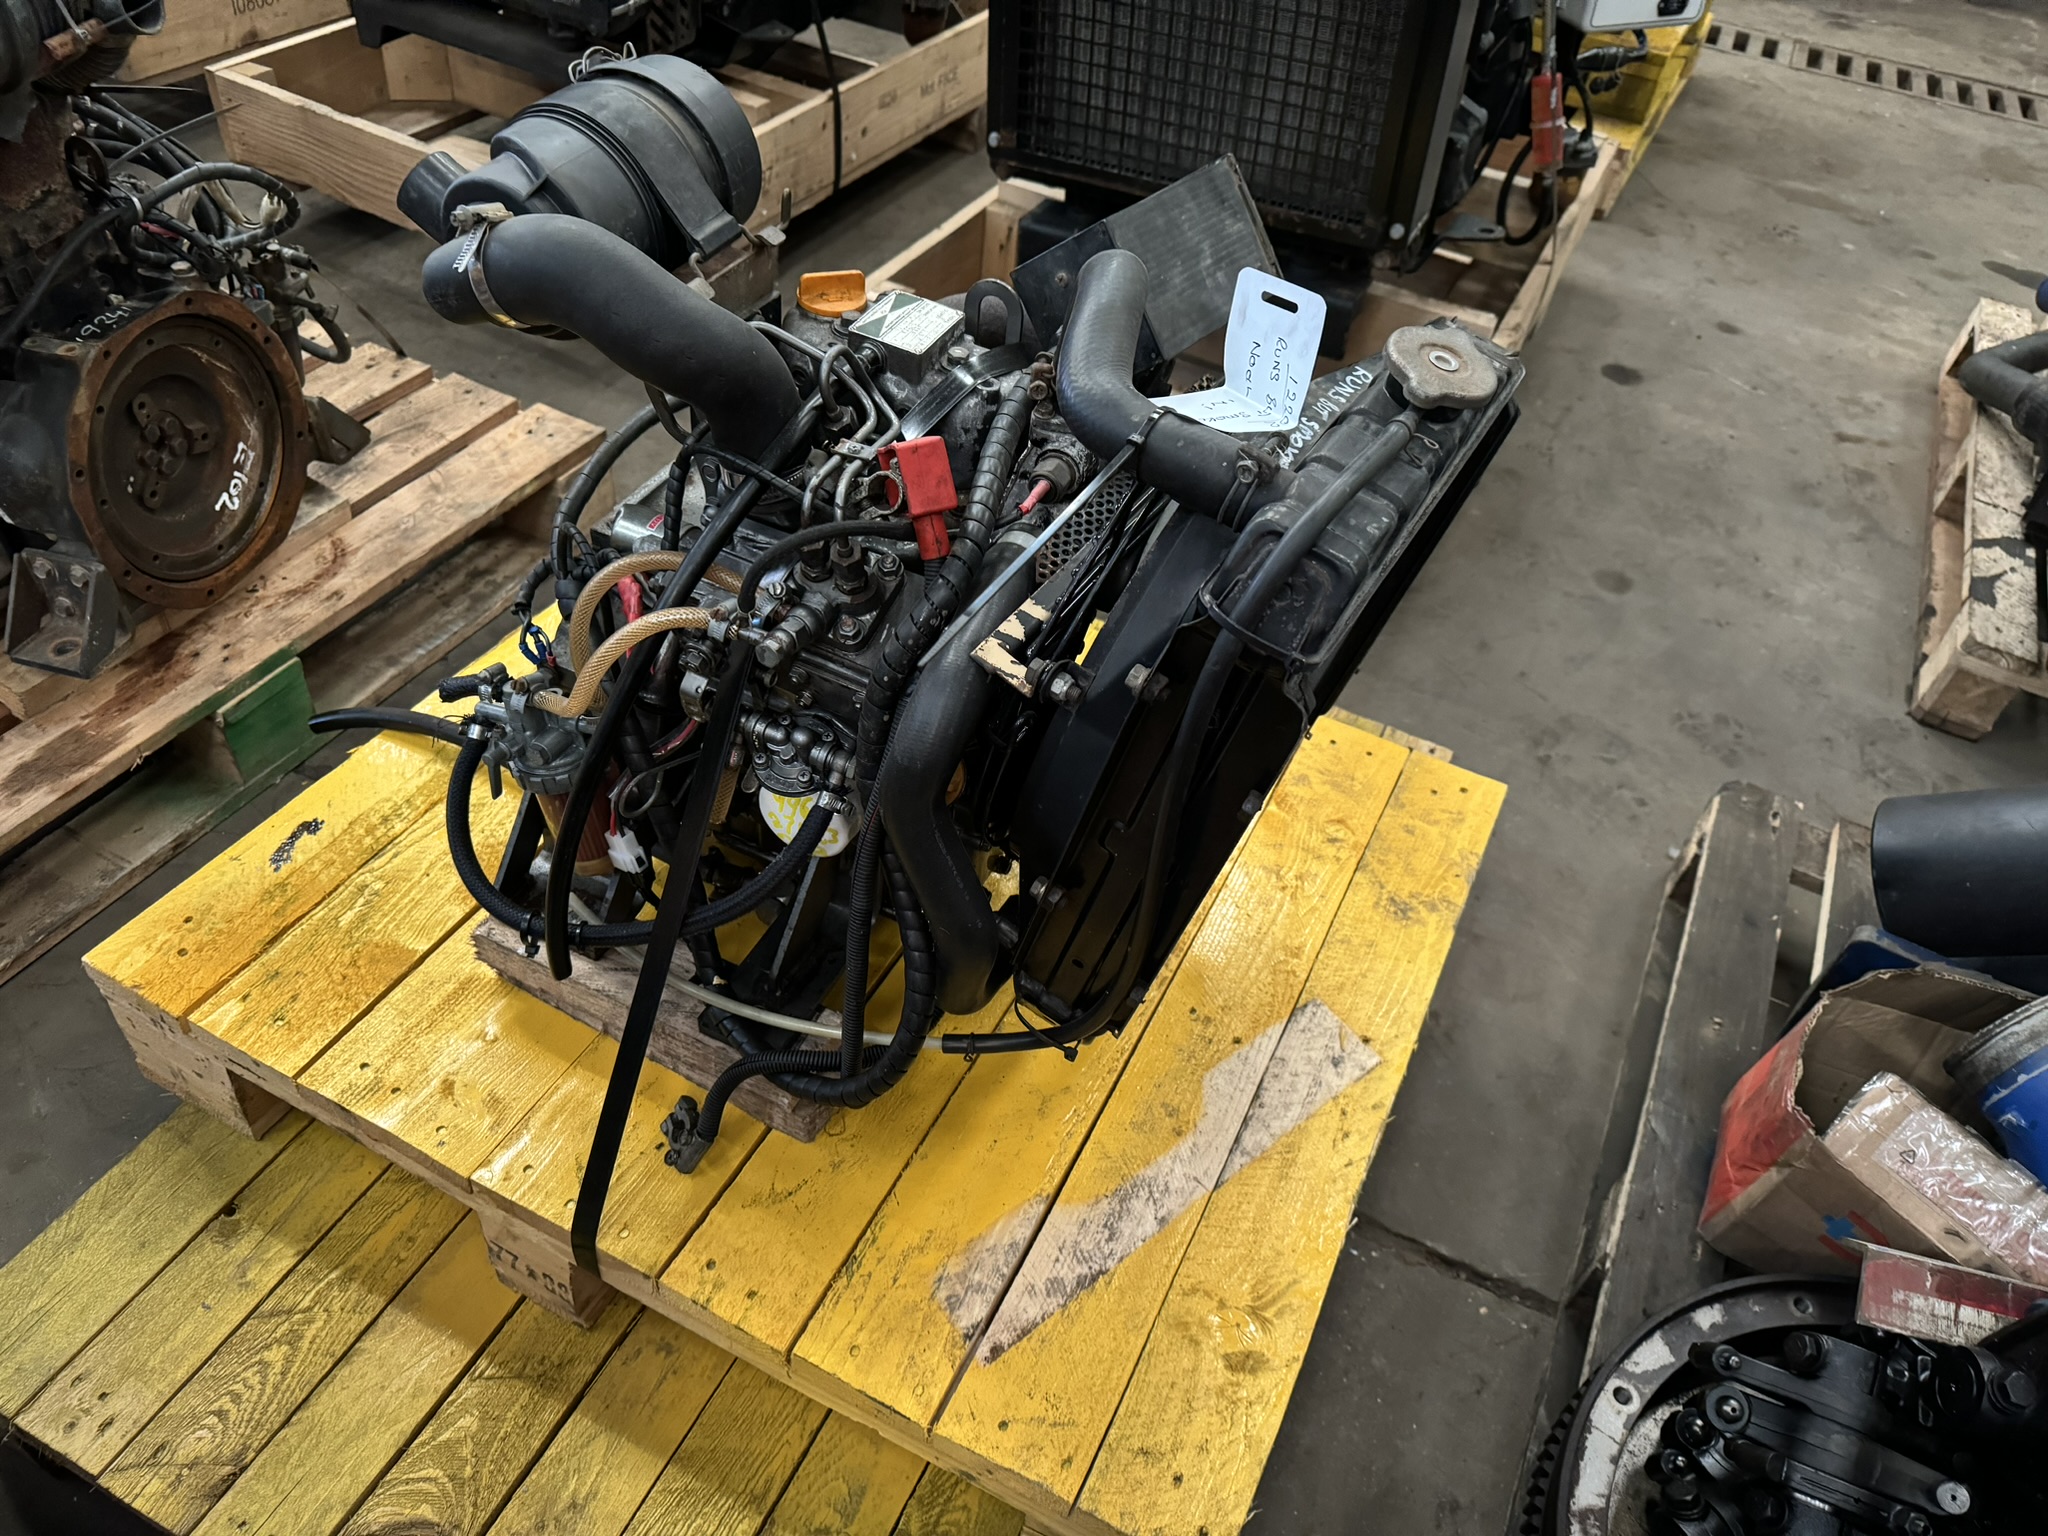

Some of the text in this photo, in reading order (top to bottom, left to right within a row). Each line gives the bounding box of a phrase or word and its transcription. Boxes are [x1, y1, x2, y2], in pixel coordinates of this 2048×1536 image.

[1269, 336, 1288, 382] RUNS
[1327, 365, 1373, 403] RUNS
[1311, 397, 1340, 422] BUT
